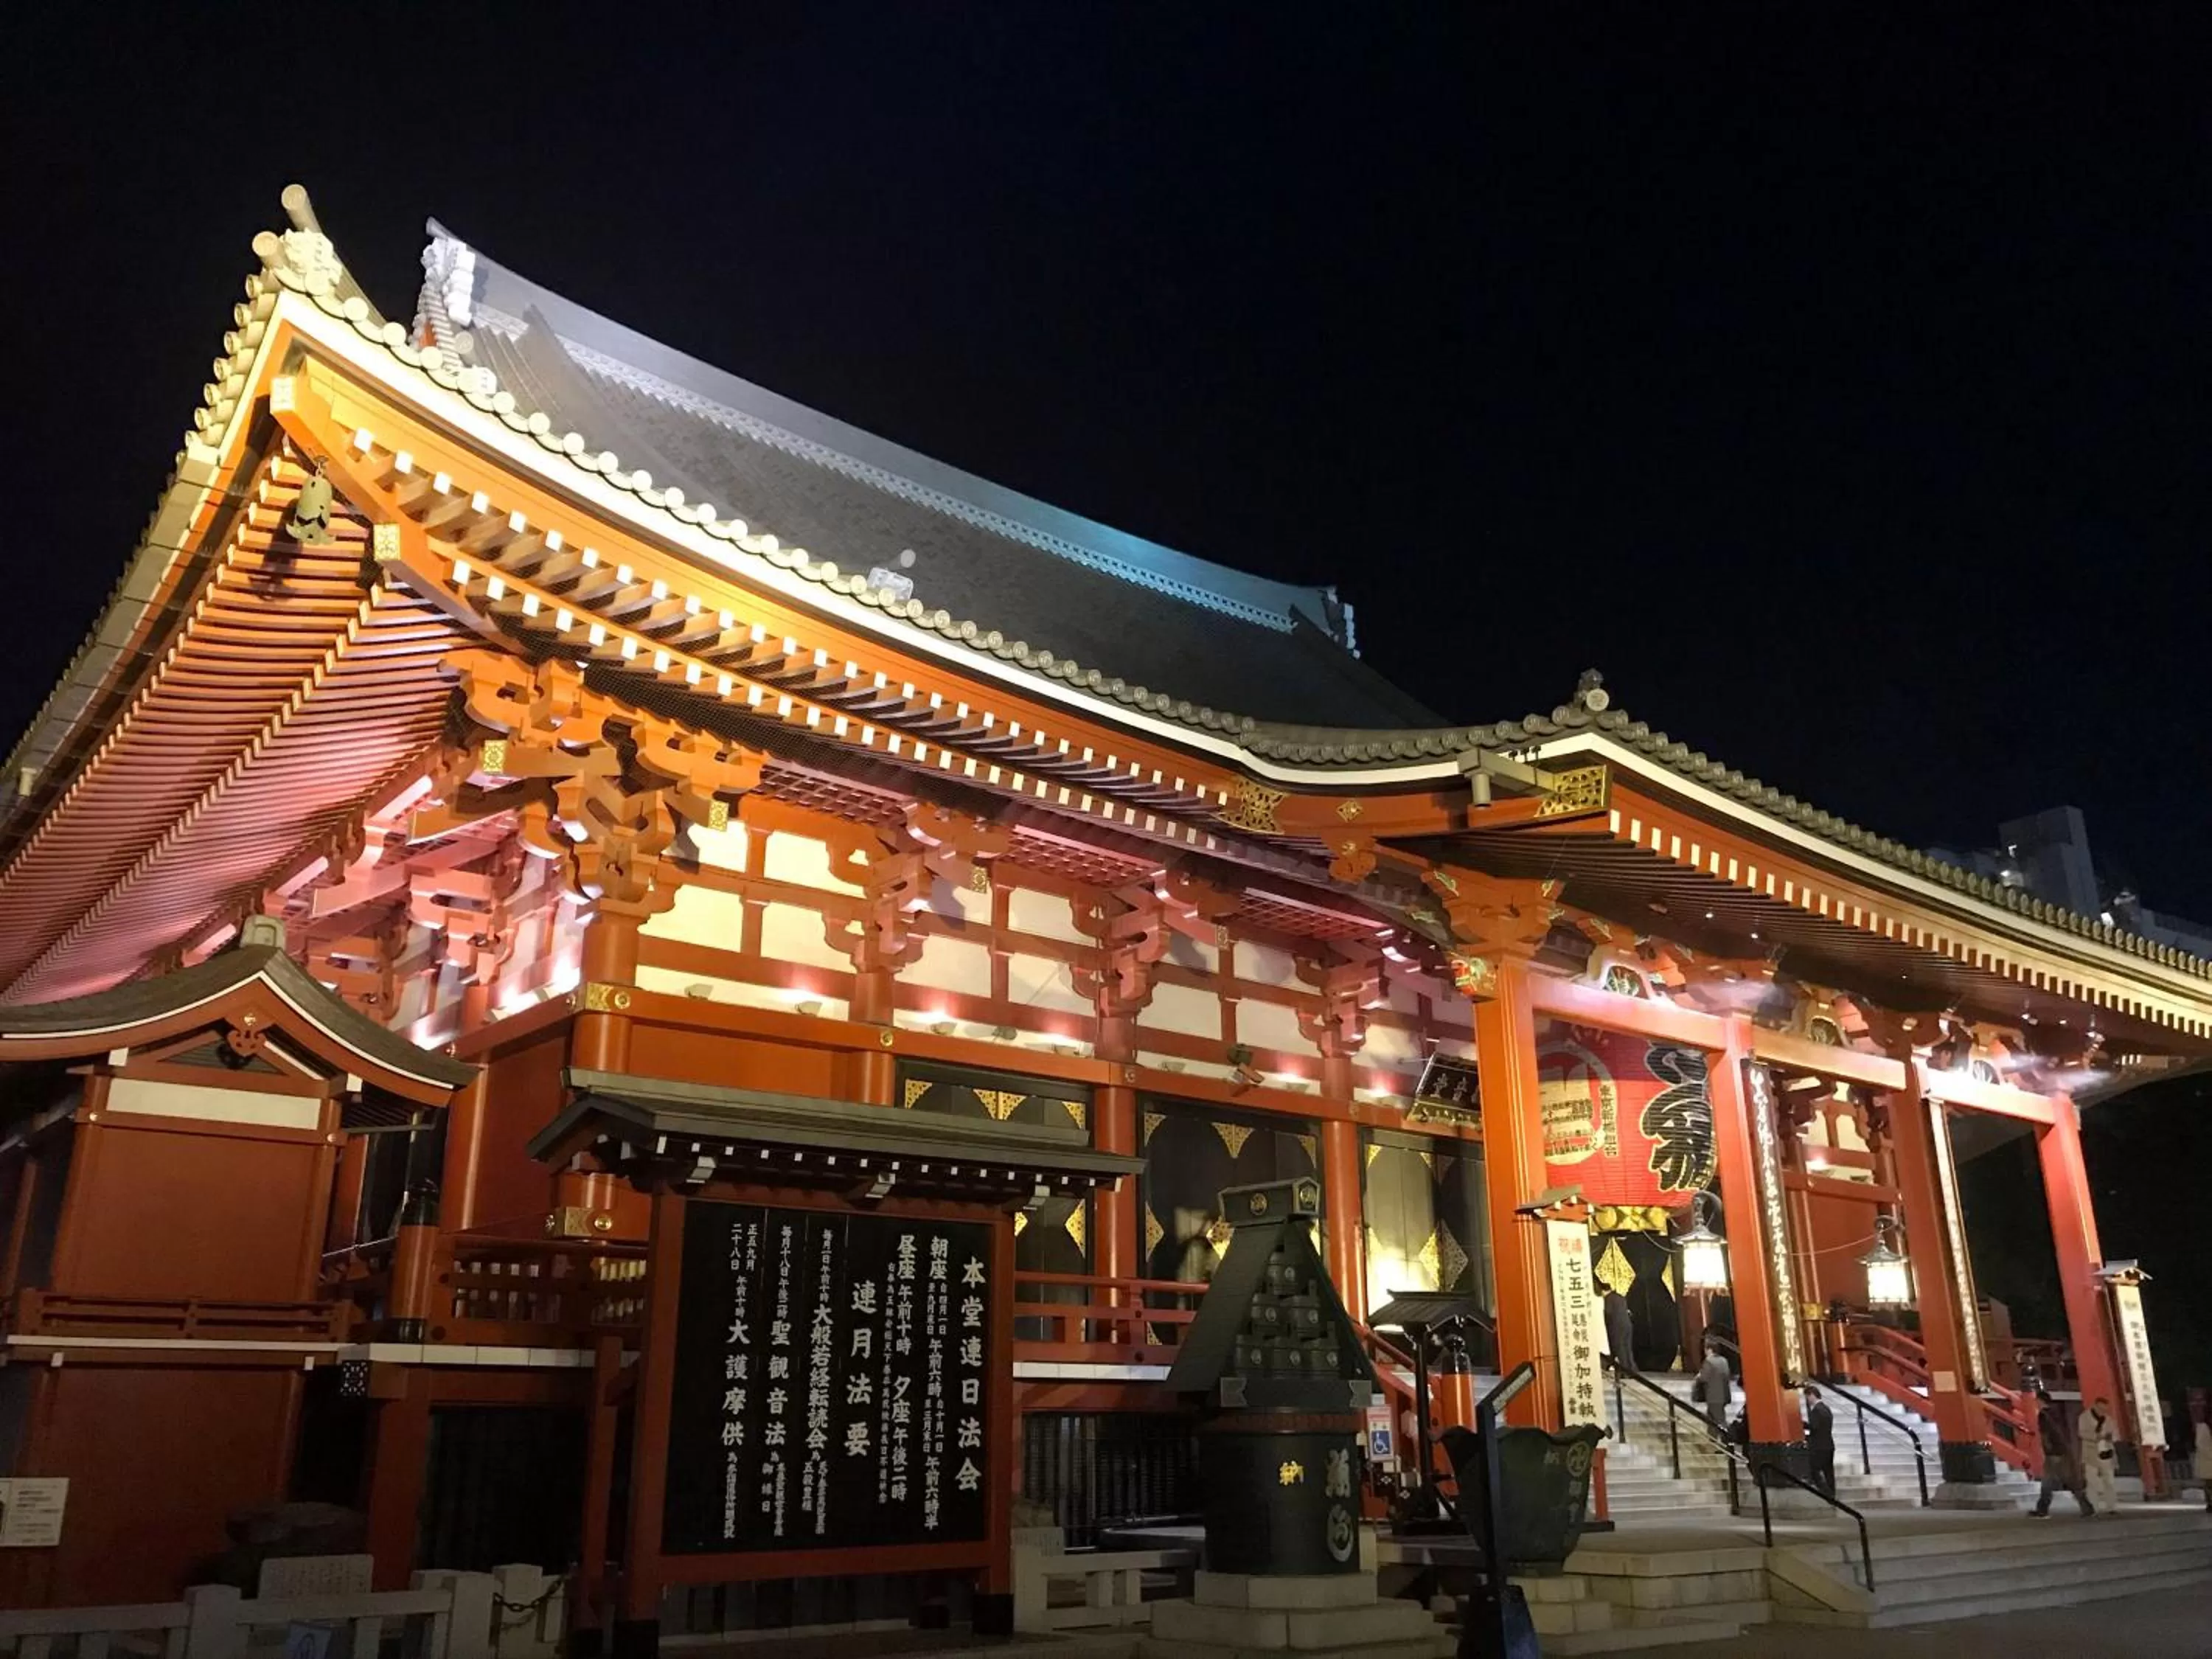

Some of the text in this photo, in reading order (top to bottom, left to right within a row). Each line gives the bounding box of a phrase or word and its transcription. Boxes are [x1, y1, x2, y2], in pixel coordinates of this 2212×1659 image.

[929, 1235, 949, 1280] 朝座
[1566, 1256, 1585, 1309] 七五三
[721, 1319, 751, 1446] 大護摩供
[765, 1320, 791, 1445] 聖観音法
[844, 1279, 877, 1456] 連月法要
[955, 1256, 986, 1490] 本堂連日法会
